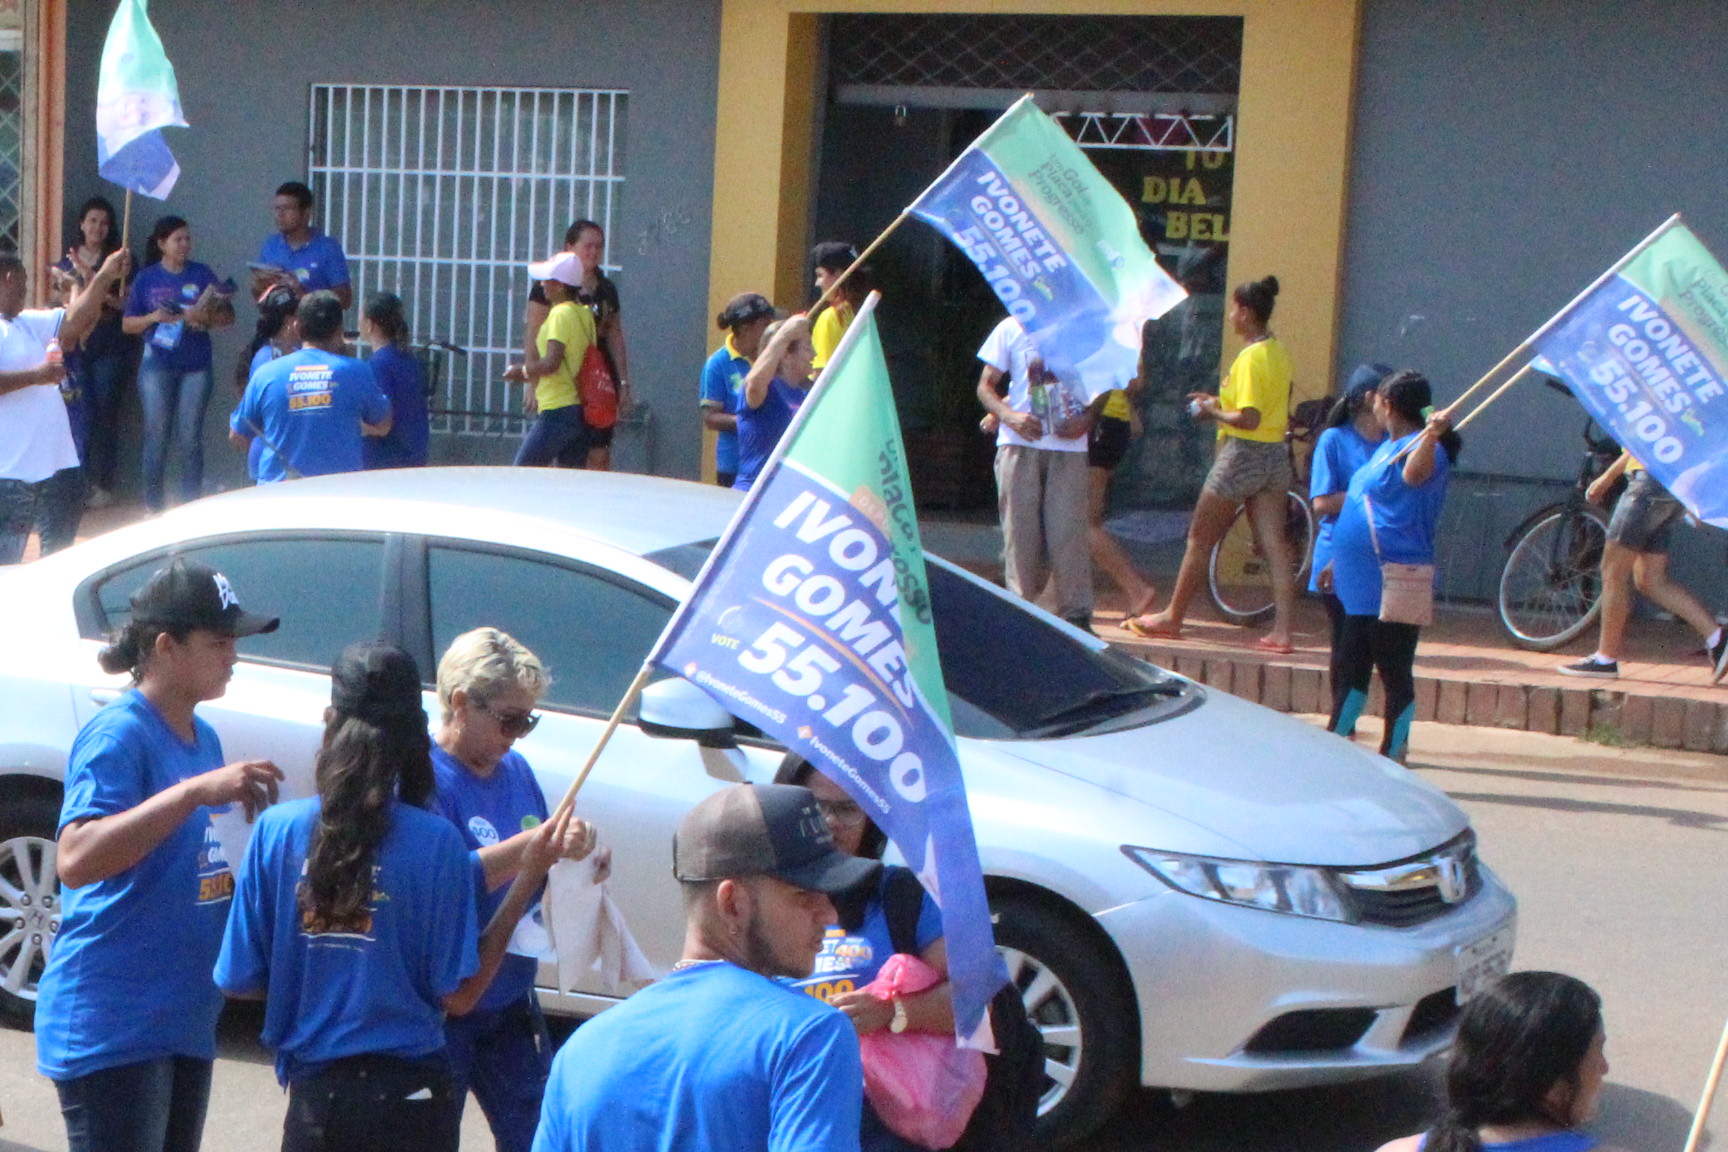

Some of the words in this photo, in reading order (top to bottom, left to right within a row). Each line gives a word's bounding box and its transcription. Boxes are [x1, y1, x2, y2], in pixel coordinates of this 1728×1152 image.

[976, 171, 1067, 273] IVONETE
[1141, 176, 1207, 205] DIA
[971, 195, 1042, 279] GOMES
[293, 381, 329, 392] GOMES
[1608, 323, 1692, 413] GOMES
[1617, 295, 1724, 404] IVONETE
[1589, 358, 1684, 464] 55.100
[773, 490, 902, 628] IVON
[710, 632, 740, 650] VOTE
[762, 553, 917, 709] GOMES
[695, 669, 788, 725] @IvoneteGomes55
[737, 621, 927, 803] 55.100
[809, 735, 892, 815] IvoneteGomes55
